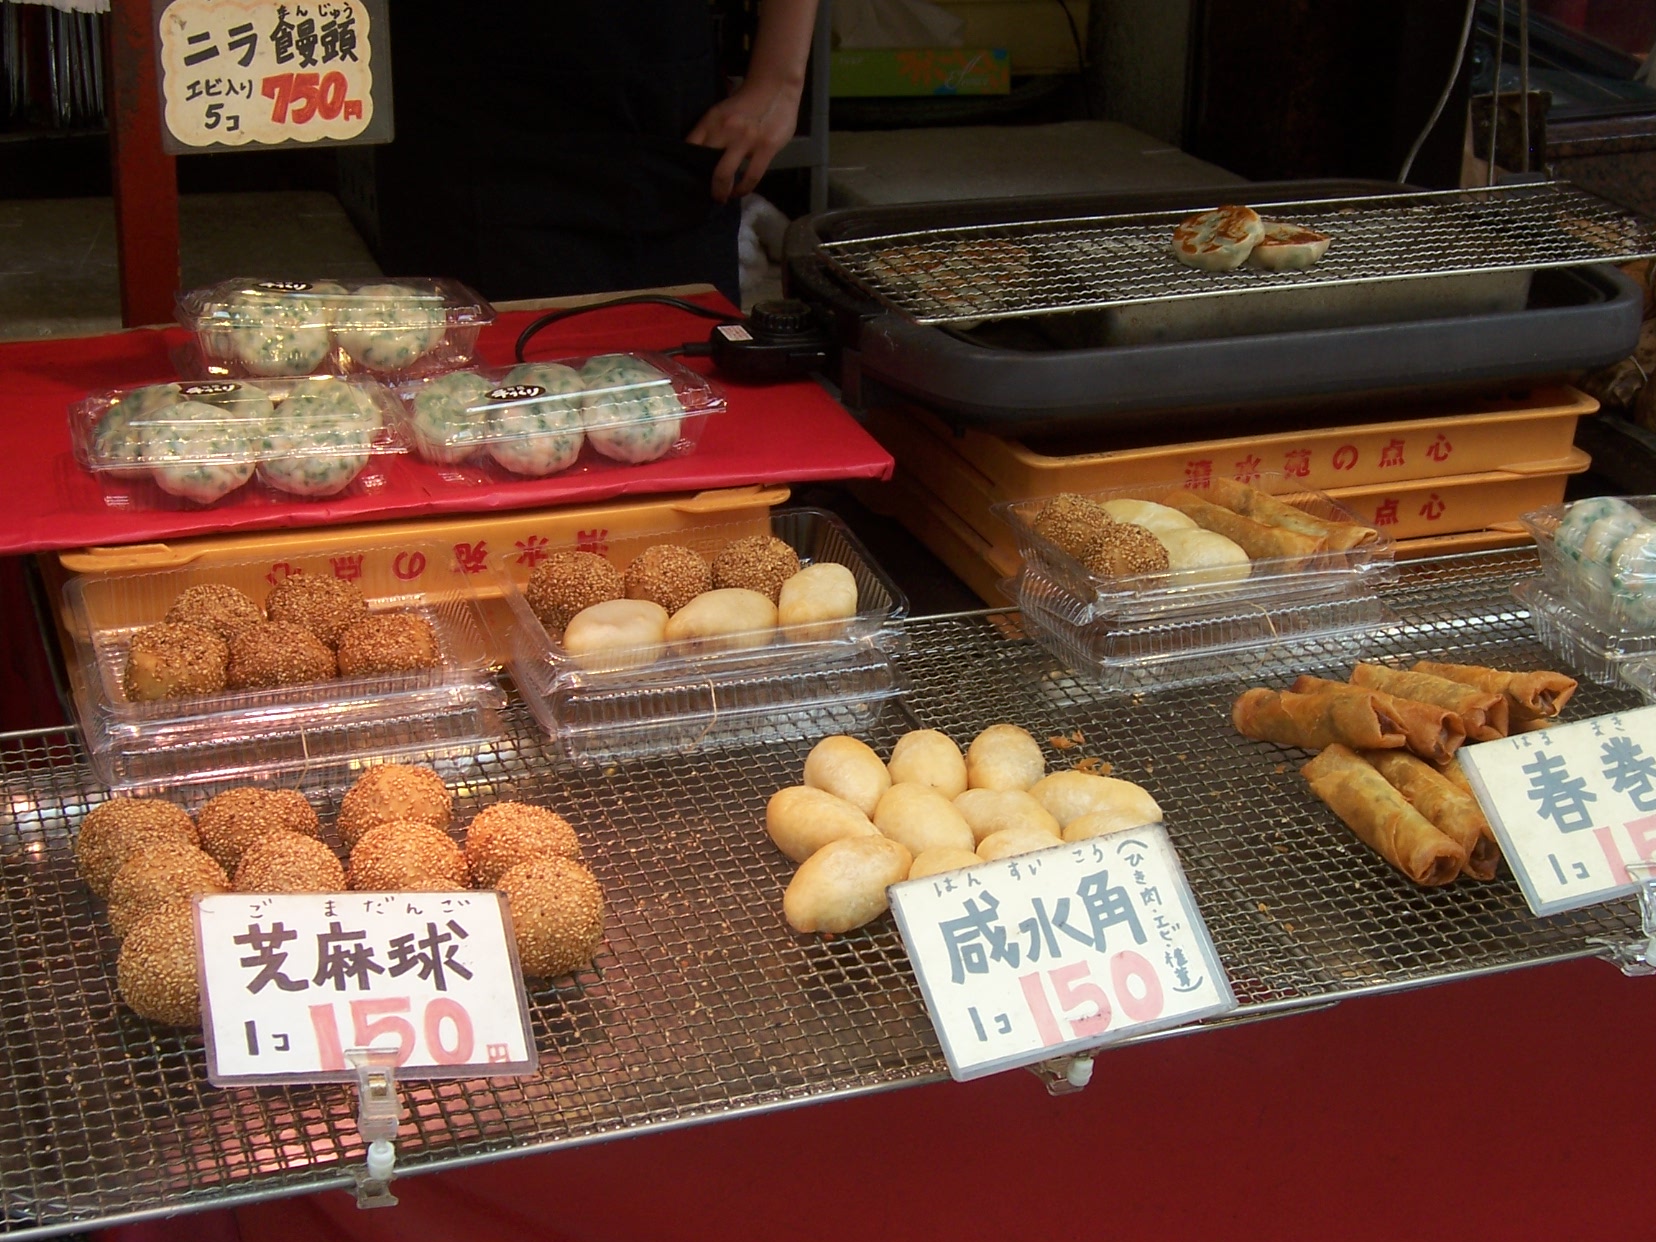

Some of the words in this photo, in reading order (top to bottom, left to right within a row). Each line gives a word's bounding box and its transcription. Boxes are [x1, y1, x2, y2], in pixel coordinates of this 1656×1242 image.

[277, 2, 354, 18] まんじゅう
[185, 78, 254, 101] エビ入り
[261, 70, 363, 124] 750円
[204, 103, 240, 132] 5コ
[1184, 434, 1454, 490] 清水苑の点心
[1547, 853, 1591, 885] 1コ
[249, 896, 471, 919] ごまだんご
[233, 920, 473, 994] 芝麻球
[967, 1006, 1012, 1042] 1コ
[1018, 950, 1165, 1047] 150
[245, 1020, 290, 1056] 1コ
